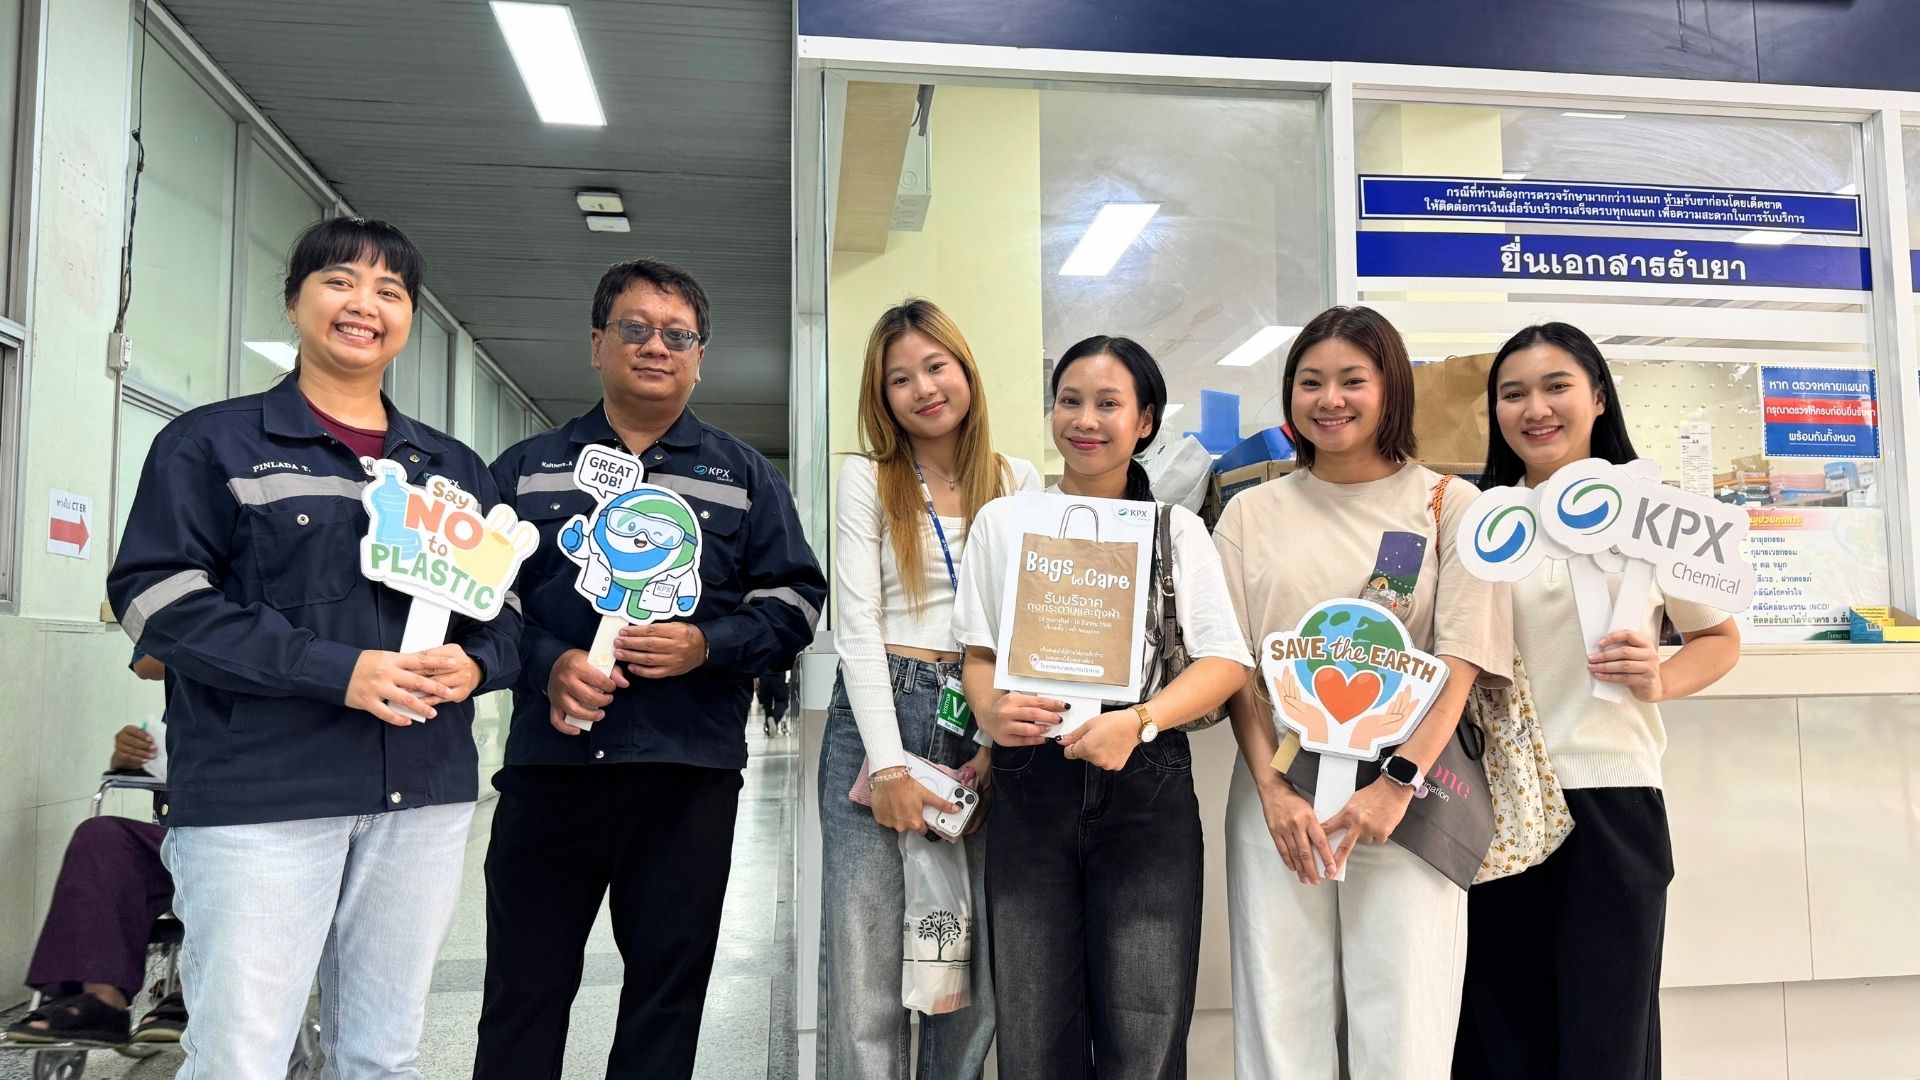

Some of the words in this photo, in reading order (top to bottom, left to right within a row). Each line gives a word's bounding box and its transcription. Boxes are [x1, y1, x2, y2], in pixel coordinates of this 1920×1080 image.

[1424, 198, 1655, 220] ให้ติดต่อการเงินเมื่อรับบริการเสร็จครบทุกแผนก
[1658, 208, 1805, 224] เพื่อความสะดวกในการรับบริการ
[1501, 236, 1746, 280] ยื่นเอกสารรับยา
[1769, 380, 1788, 390] หาก
[1792, 381, 1869, 392] ตรวจหลายแผนก
[1766, 404, 1876, 417] กรุณาตรวจให้ครบก่อนยื่นรับา
[1789, 428, 1856, 443] พร้อมกันทั้งหมด
[252, 462, 299, 473] PINLADA
[589, 457, 633, 479] GREAT
[708, 467, 731, 478] KPX
[591, 473, 623, 489] JOB!
[432, 481, 469, 510] Say
[405, 493, 484, 550] NO
[1130, 509, 1148, 518] KPX
[1632, 497, 1734, 565] KPX
[428, 536, 448, 557] to
[371, 543, 495, 610] PLASTIC
[1026, 551, 1074, 582] Bags
[1072, 575, 1084, 586] to
[1085, 568, 1130, 590] Care
[1672, 562, 1741, 595] Chemical
[656, 585, 671, 593] KPX
[1045, 591, 1103, 608] รับบริจาค
[1028, 602, 1120, 619] ถุงกระดาษและถุงผ้า
[1271, 637, 1326, 661] SAVE
[1330, 637, 1367, 663] the
[1370, 645, 1438, 684] EARTH
[952, 695, 968, 719] V
